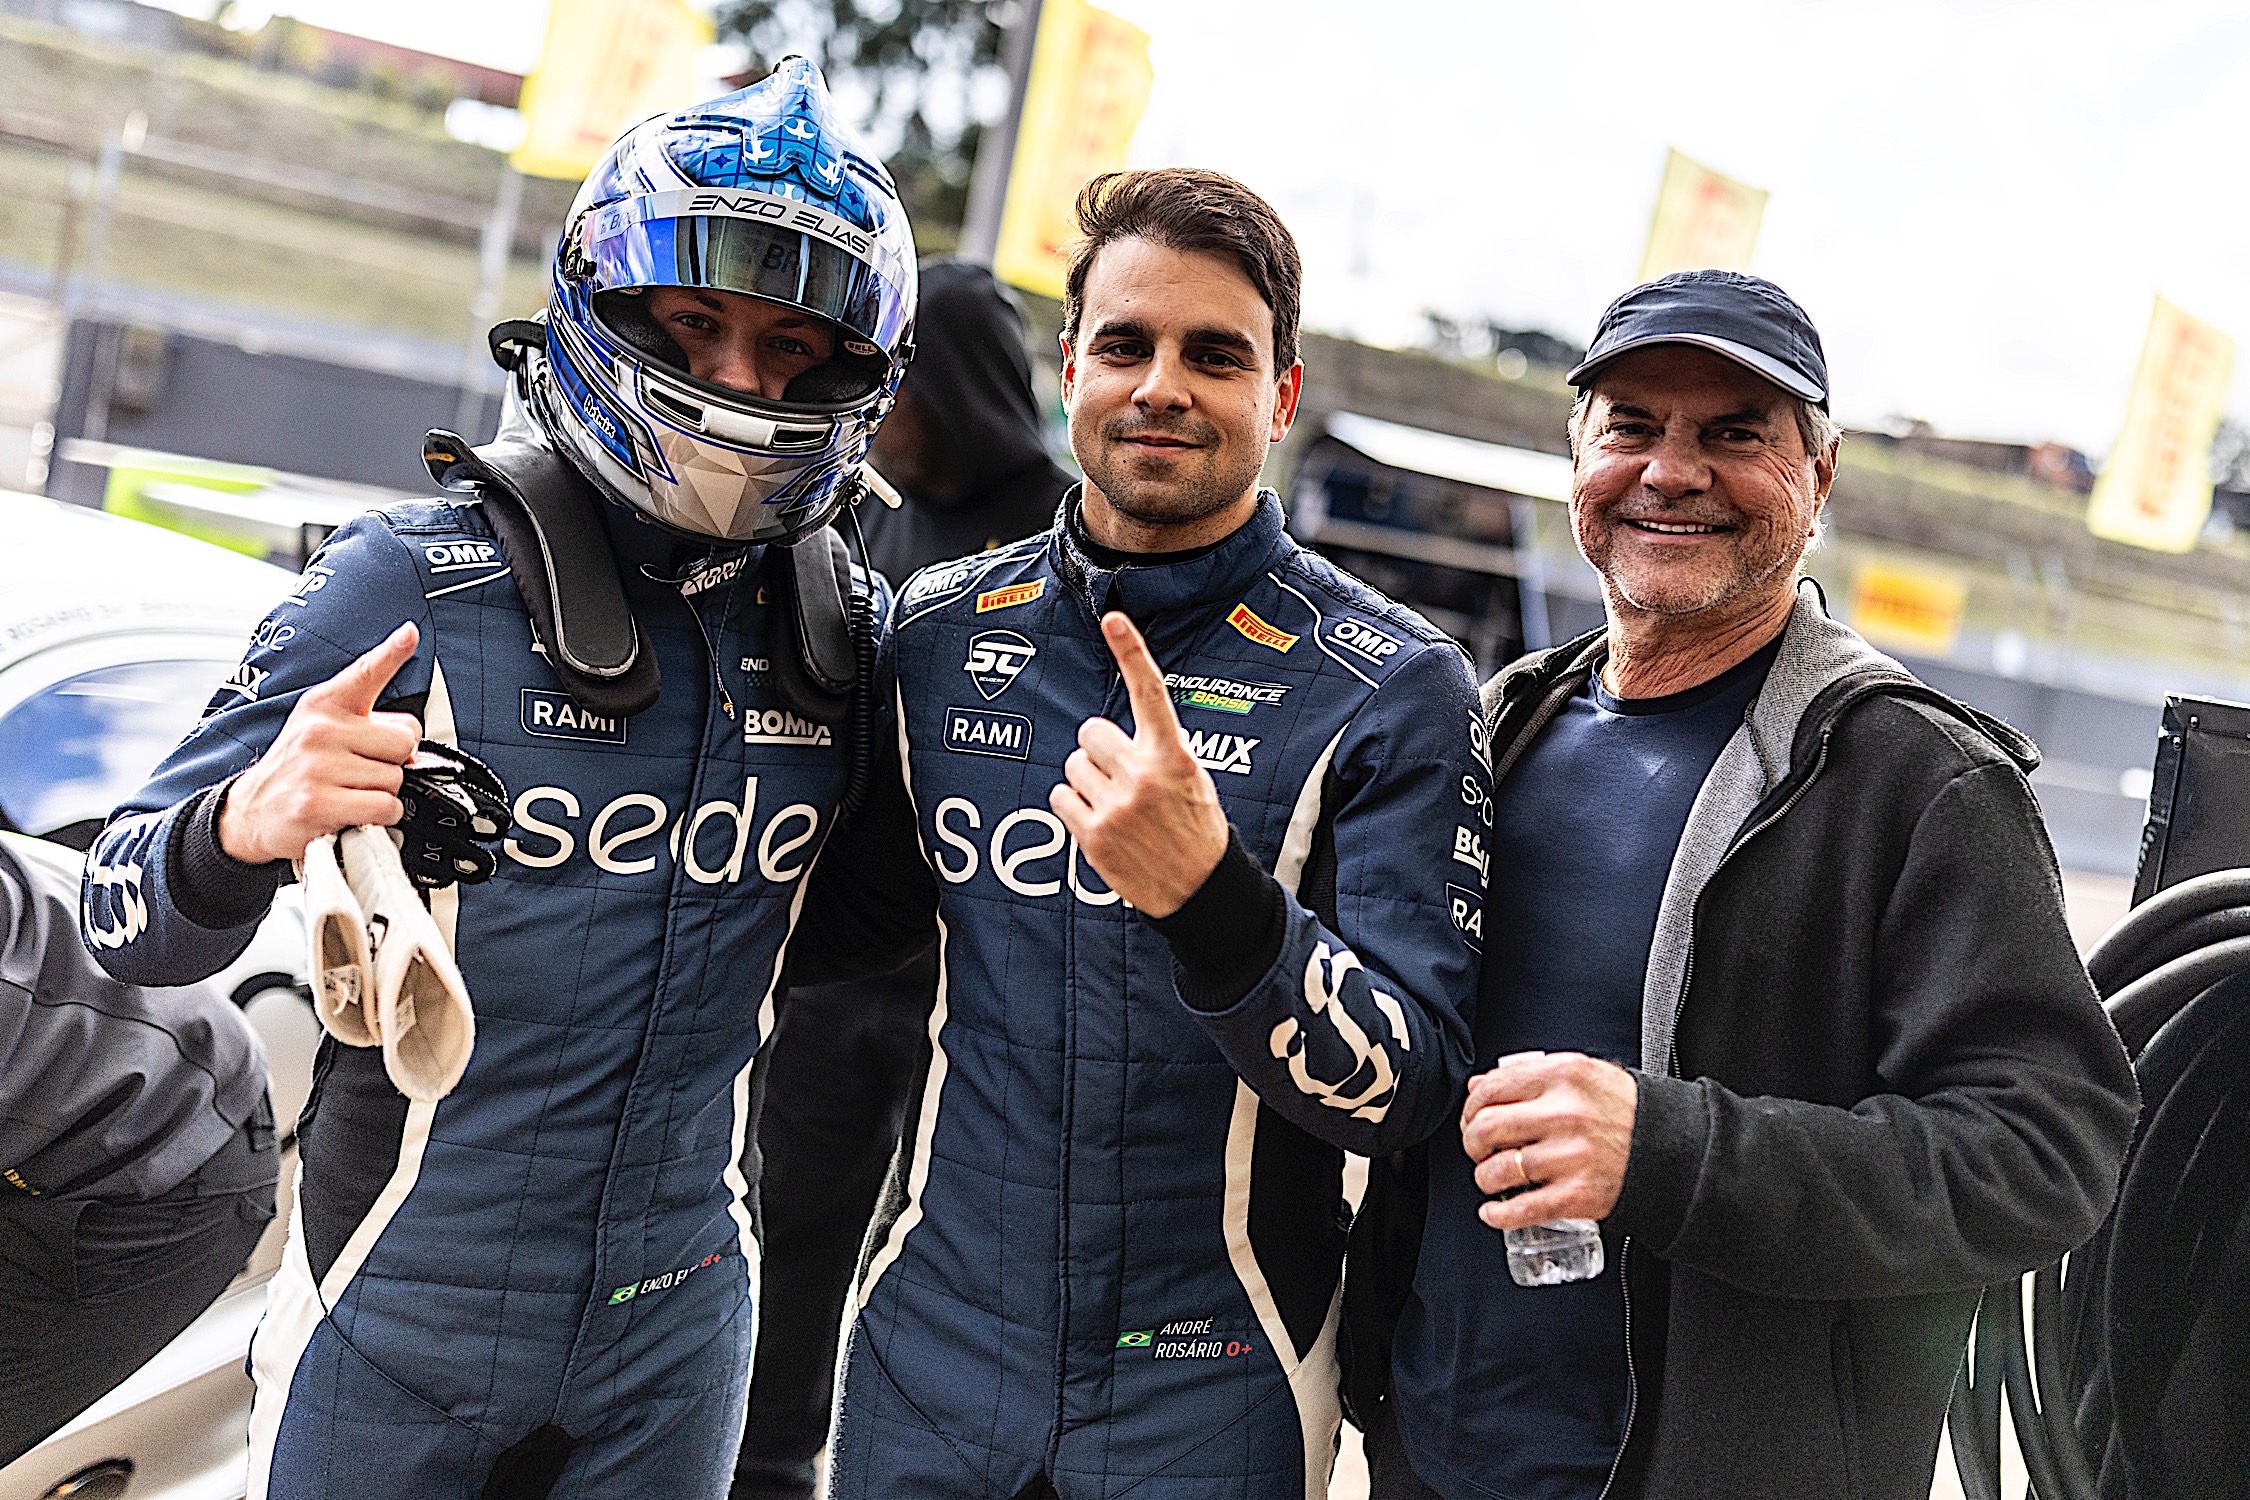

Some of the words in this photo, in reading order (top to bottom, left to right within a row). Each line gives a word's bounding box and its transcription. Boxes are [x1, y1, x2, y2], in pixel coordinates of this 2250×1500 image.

[688, 194, 787, 219] ENZO
[791, 210, 871, 255] ELIAS
[425, 544, 496, 566] OMP
[911, 569, 969, 599] OMP
[981, 582, 1042, 609] PIRELLI
[1233, 607, 1293, 649] PIRELLI
[1334, 622, 1399, 657] OMP
[1164, 673, 1287, 703] ENDURANCE
[1191, 690, 1250, 711] BRASIL
[951, 717, 1022, 749] RAMI
[503, 777, 818, 883] sede
[640, 1272, 673, 1294] ENZO
[1160, 1316, 1214, 1336] ANDRÉ
[1155, 1339, 1222, 1358] ROSÁRIO
